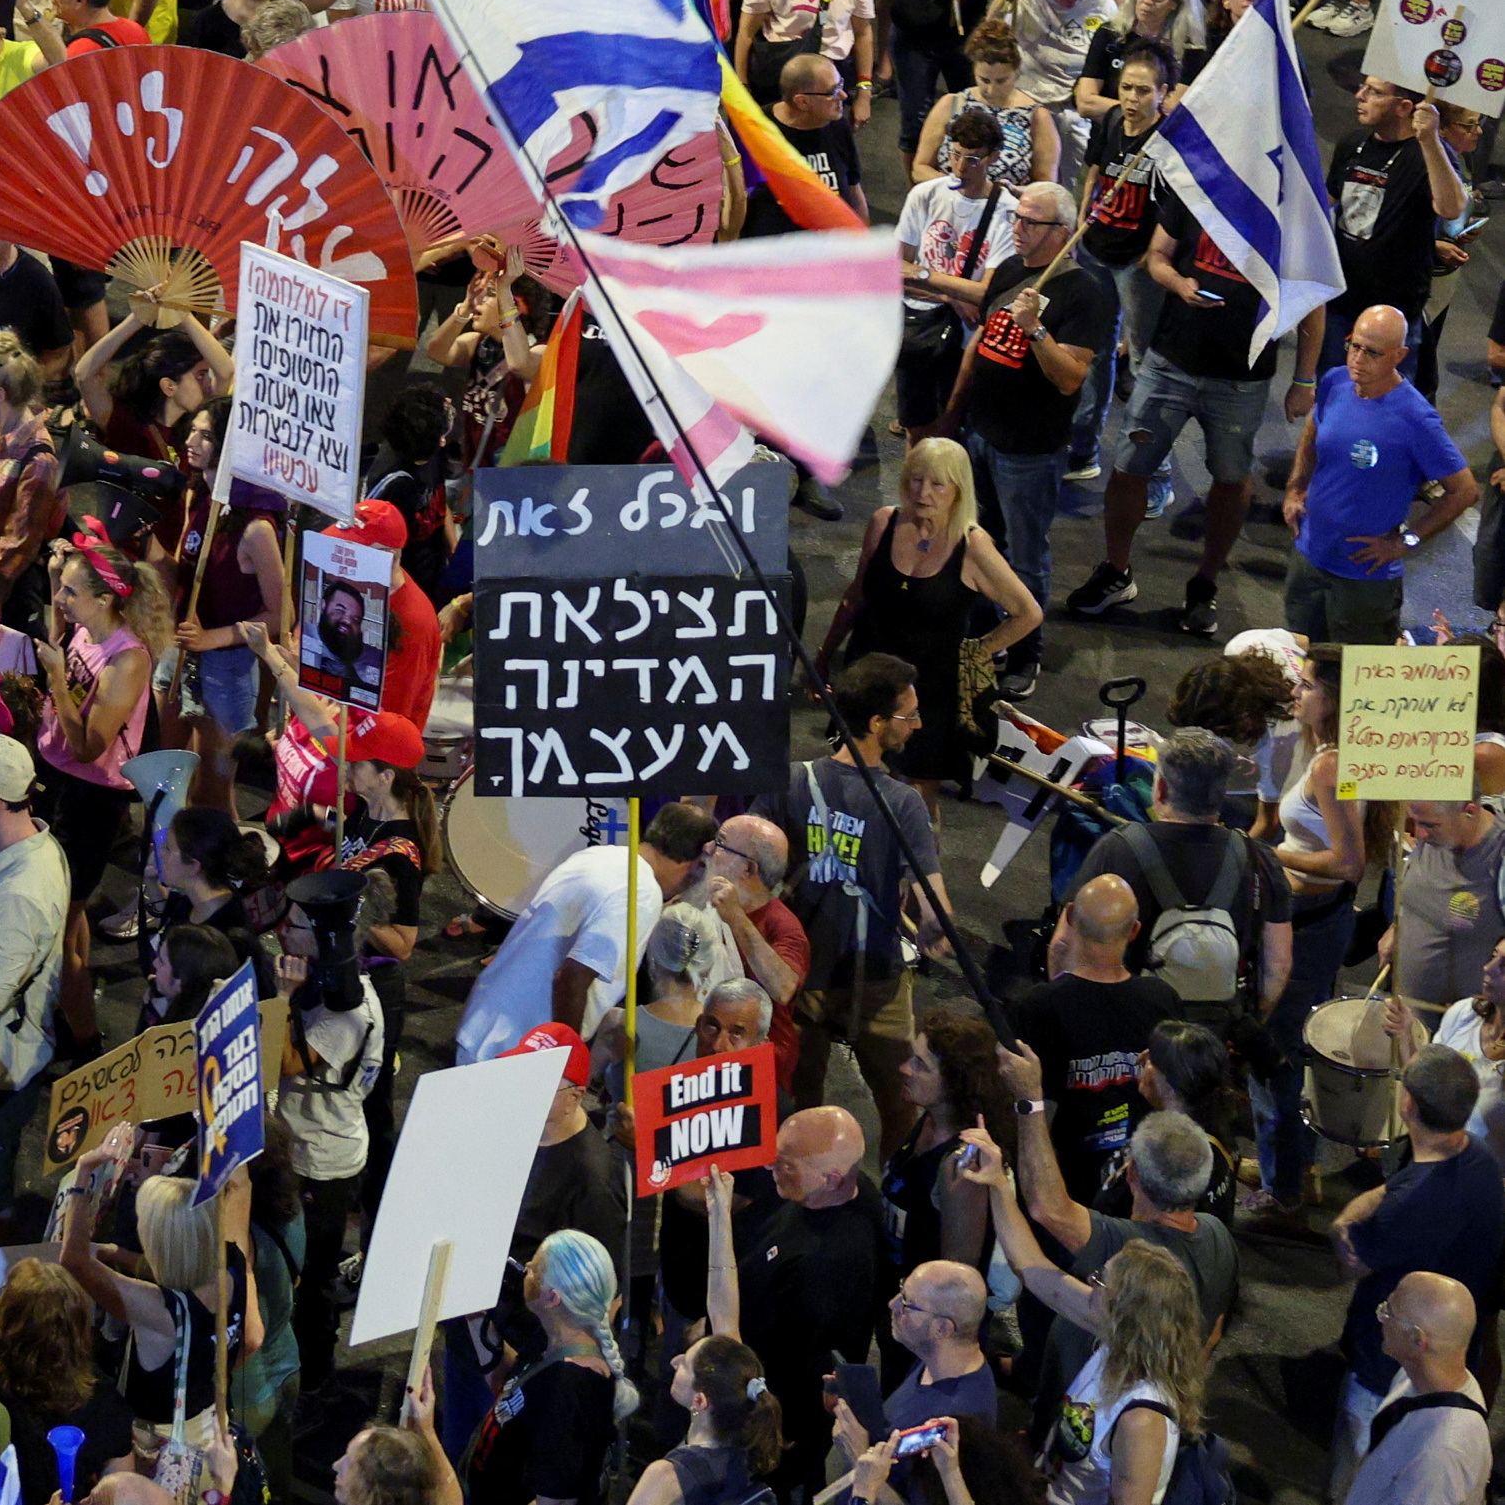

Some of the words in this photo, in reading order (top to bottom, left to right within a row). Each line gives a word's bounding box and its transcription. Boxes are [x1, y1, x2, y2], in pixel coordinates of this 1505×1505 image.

[248, 261, 329, 319] למלחמה!
[253, 303, 283, 334] את
[333, 298, 353, 332] די
[288, 318, 343, 363] החזירו
[252, 333, 340, 398] החטופים!
[255, 372, 301, 411] מעזה
[304, 395, 336, 432] צאו
[503, 653, 777, 710] המדינה
[671, 1064, 716, 1109] End
[721, 1062, 742, 1095] it
[671, 1104, 745, 1160] NOW
